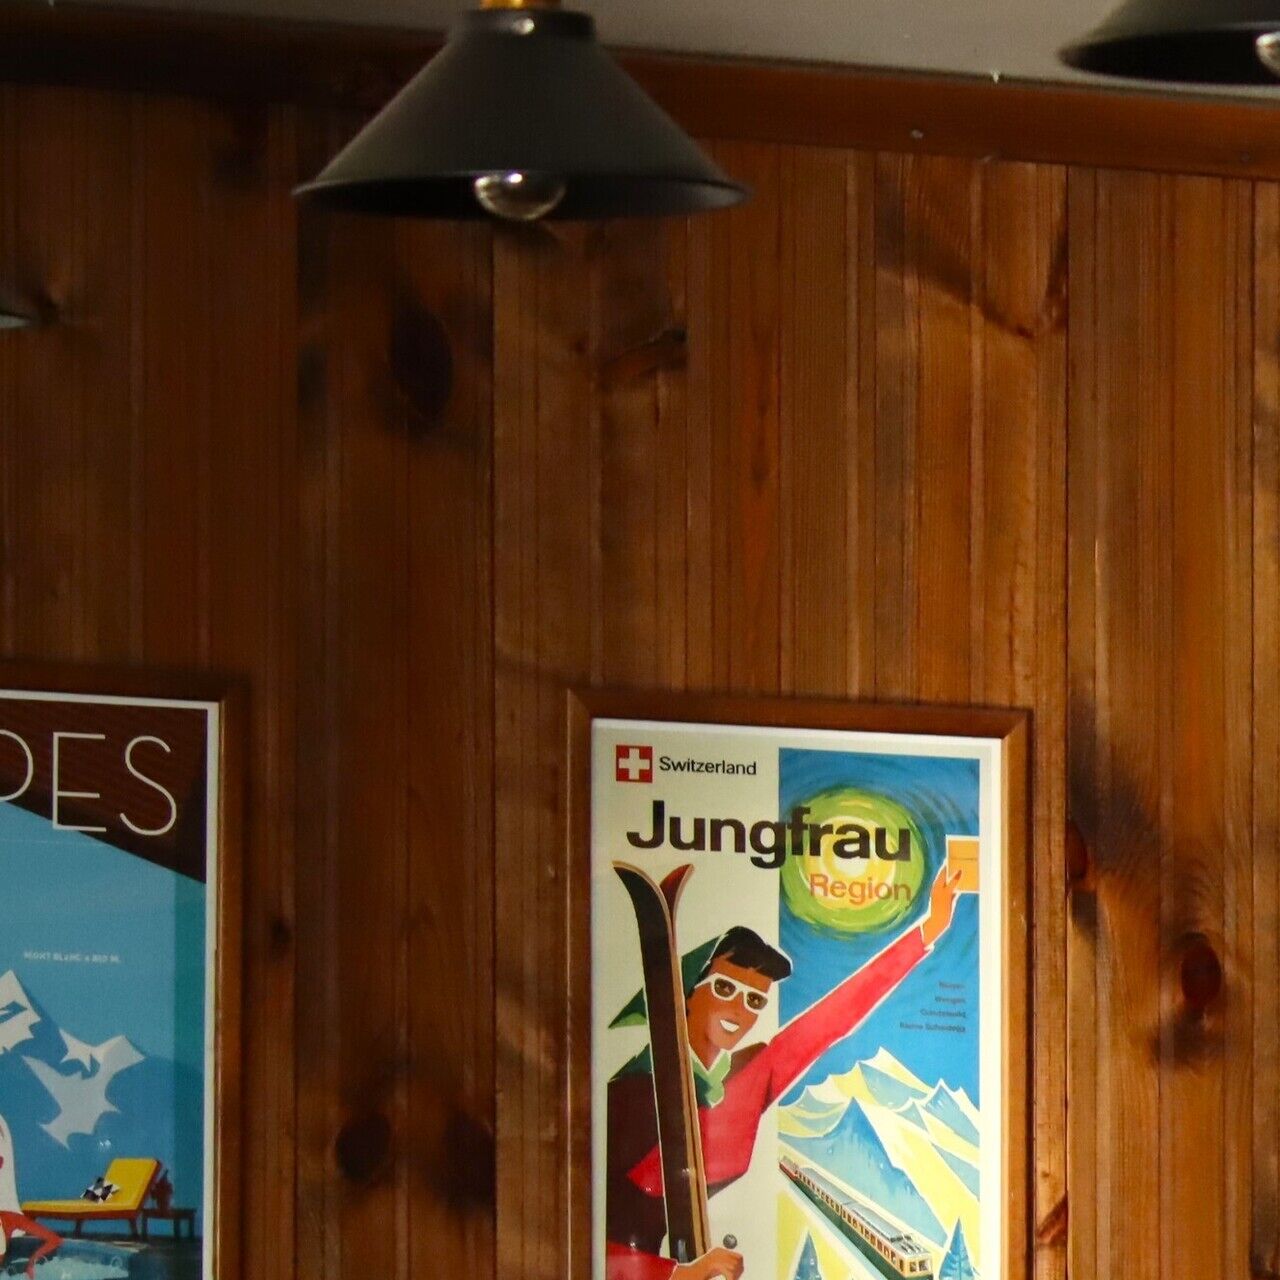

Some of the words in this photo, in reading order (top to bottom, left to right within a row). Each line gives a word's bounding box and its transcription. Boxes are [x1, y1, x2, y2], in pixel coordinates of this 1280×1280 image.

[659, 756, 757, 776] Switzerland
[626, 800, 911, 869] Jungfrau
[809, 873, 912, 905] Region
